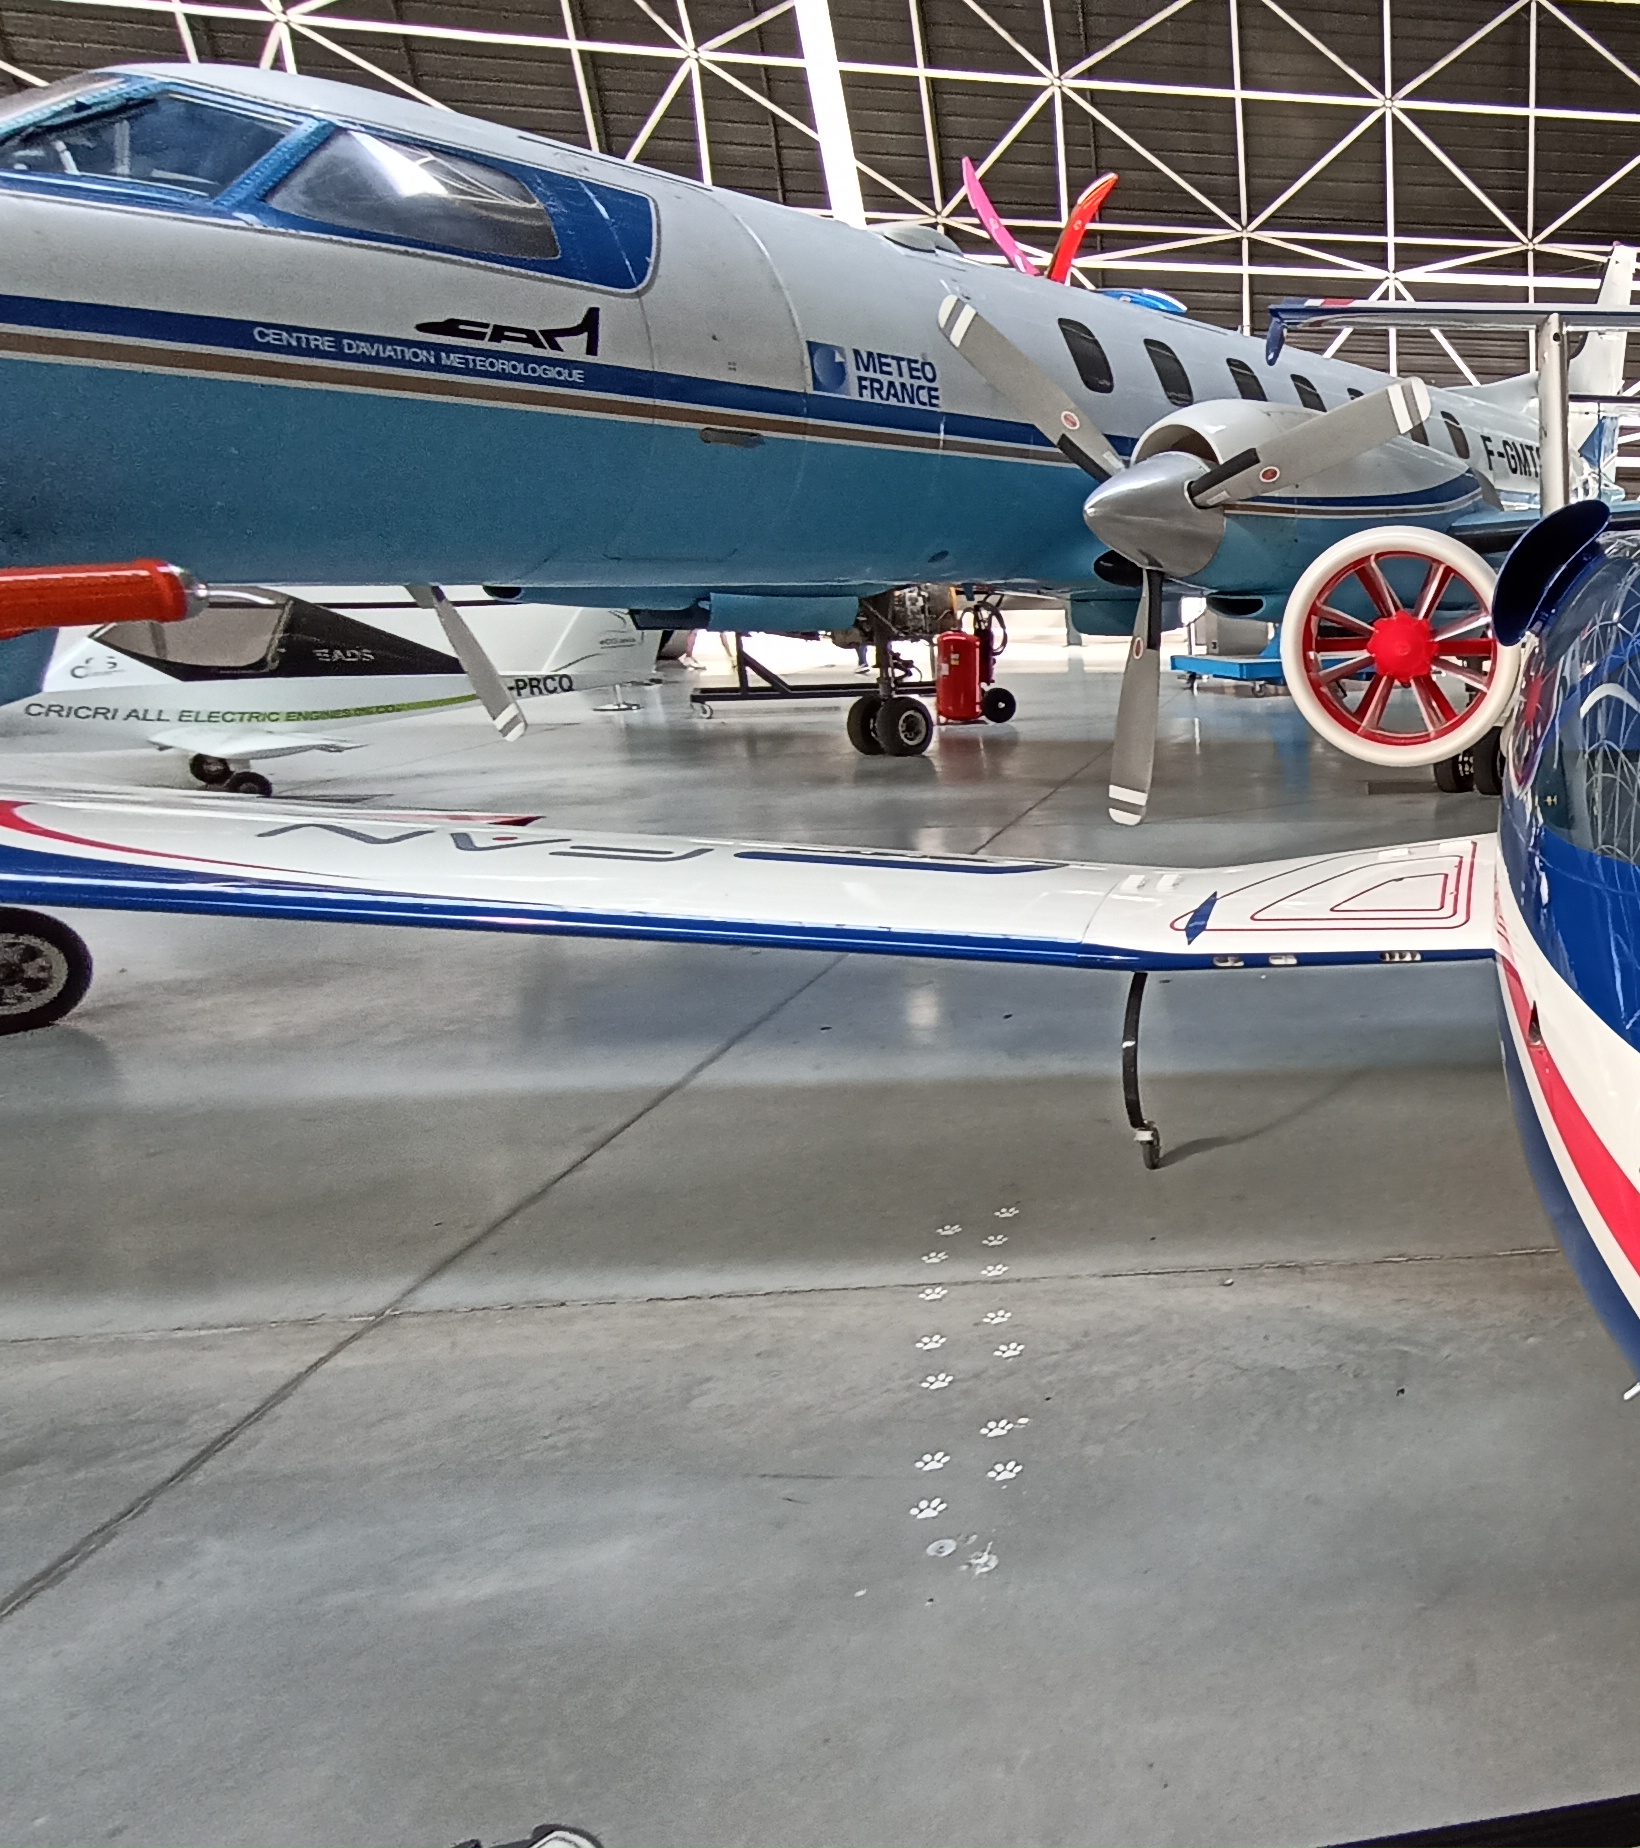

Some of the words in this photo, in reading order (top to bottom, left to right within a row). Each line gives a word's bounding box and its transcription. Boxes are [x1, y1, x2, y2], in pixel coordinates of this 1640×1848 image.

[253, 326, 336, 352] CENTRE
[343, 338, 436, 365] D'AVIATION
[440, 352, 586, 383] METEOROLOGIQUE
[852, 348, 937, 383] METEO
[857, 375, 941, 408] FRANCE
[1480, 434, 1540, 479] F-GMT
[312, 648, 375, 662] EADS
[507, 674, 574, 697] -PRCQ
[24, 703, 119, 721] CRICRI
[122, 708, 170, 722] ALL
[177, 709, 281, 723] ELECTRIC
